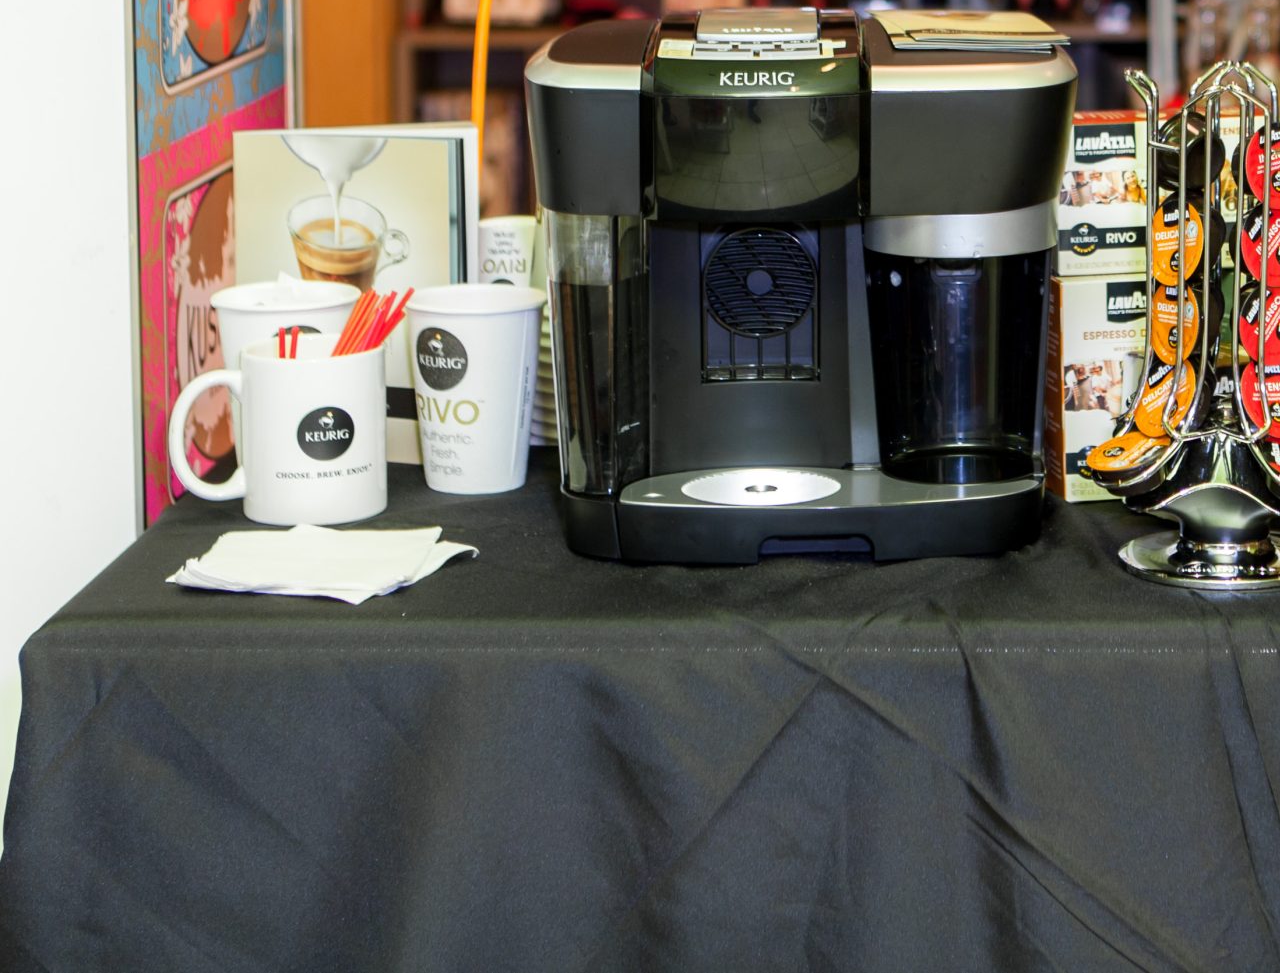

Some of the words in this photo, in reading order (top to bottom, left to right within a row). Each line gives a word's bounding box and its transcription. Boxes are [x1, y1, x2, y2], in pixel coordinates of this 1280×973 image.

[720, 72, 794, 86] KEURIG
[1075, 132, 1136, 150] LAVAZZA
[1070, 235, 1099, 243] KEURIG
[1105, 232, 1137, 244] RIVO
[482, 258, 527, 275] RIVO
[1108, 291, 1146, 310] LAVA
[186, 304, 217, 380] KUS
[1083, 329, 1137, 341] ESPRESSO
[418, 354, 463, 370] KEURIG
[416, 393, 480, 425] RIVO
[305, 429, 350, 443] KEURIG
